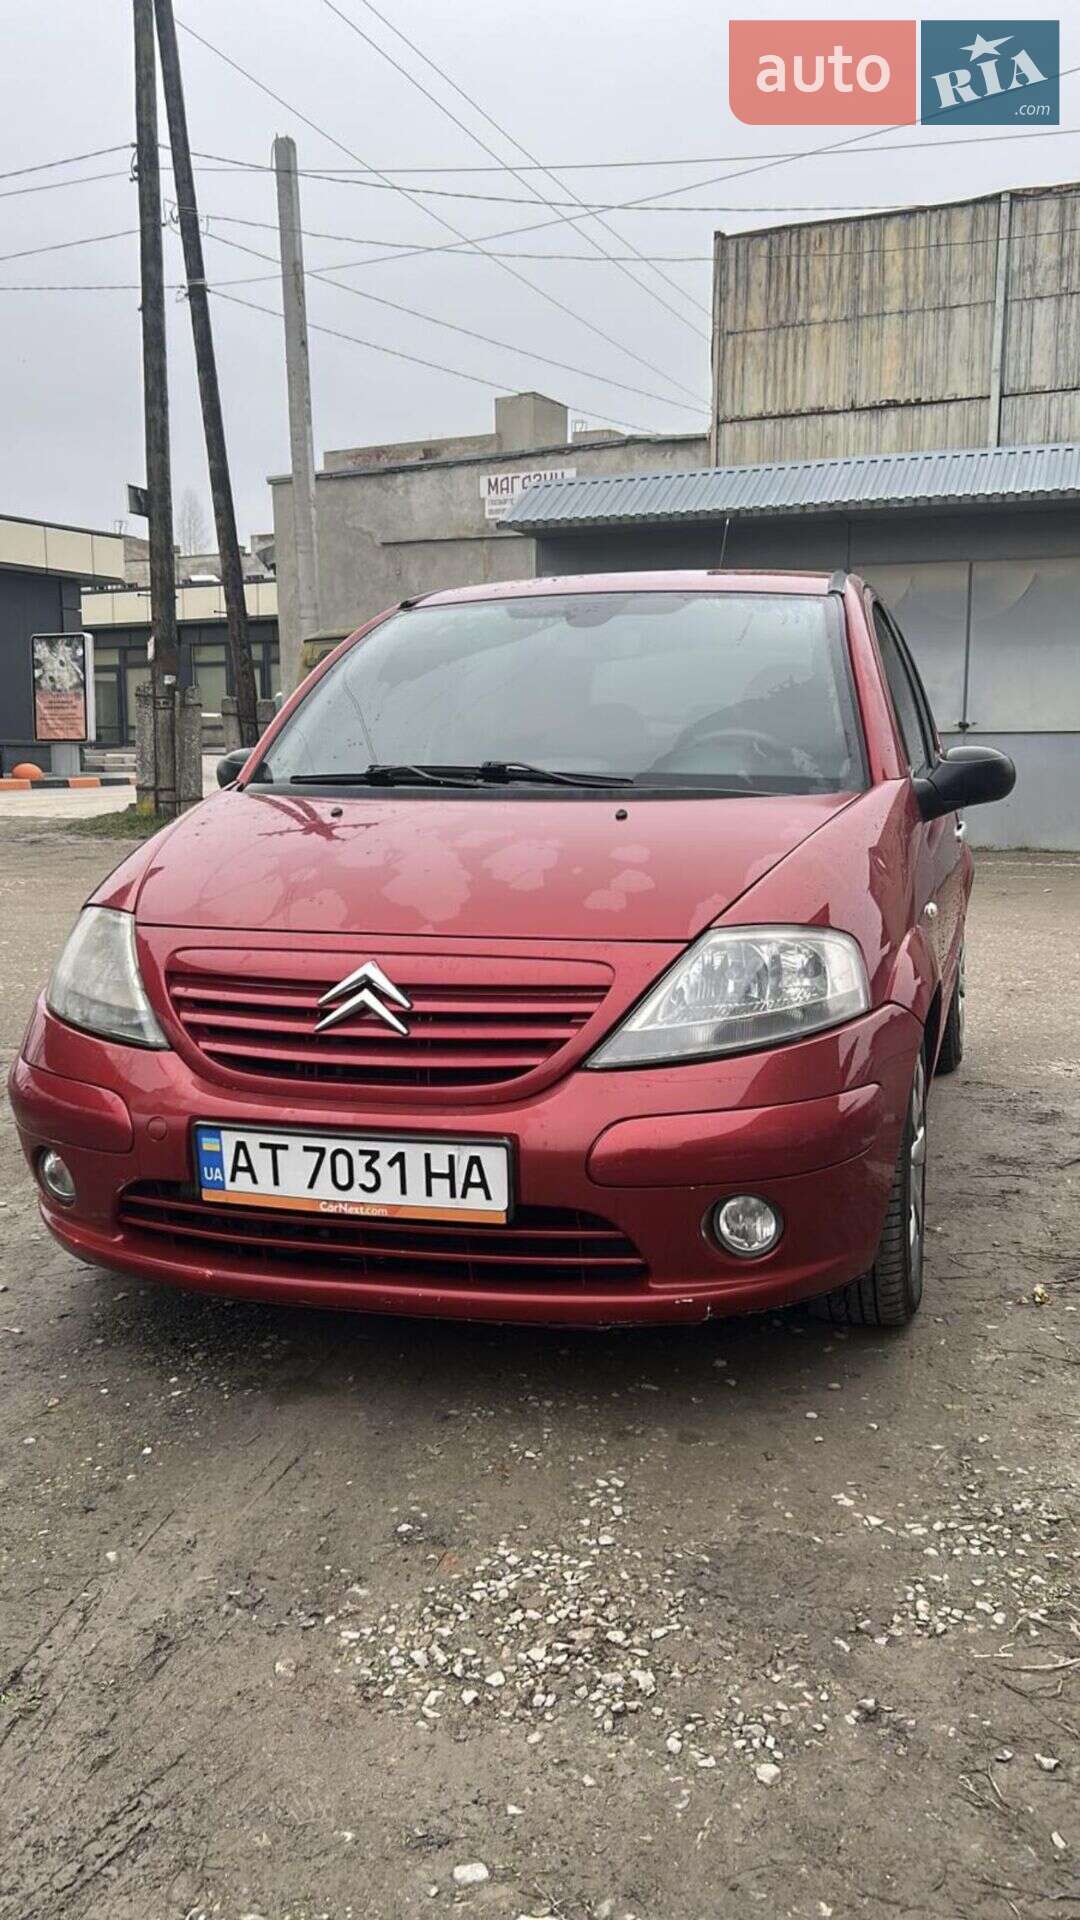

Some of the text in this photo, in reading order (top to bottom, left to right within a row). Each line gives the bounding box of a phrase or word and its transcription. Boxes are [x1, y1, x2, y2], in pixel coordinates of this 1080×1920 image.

[203, 1166, 225, 1182] UA
[229, 1140, 493, 1201] AT 7031 HA
